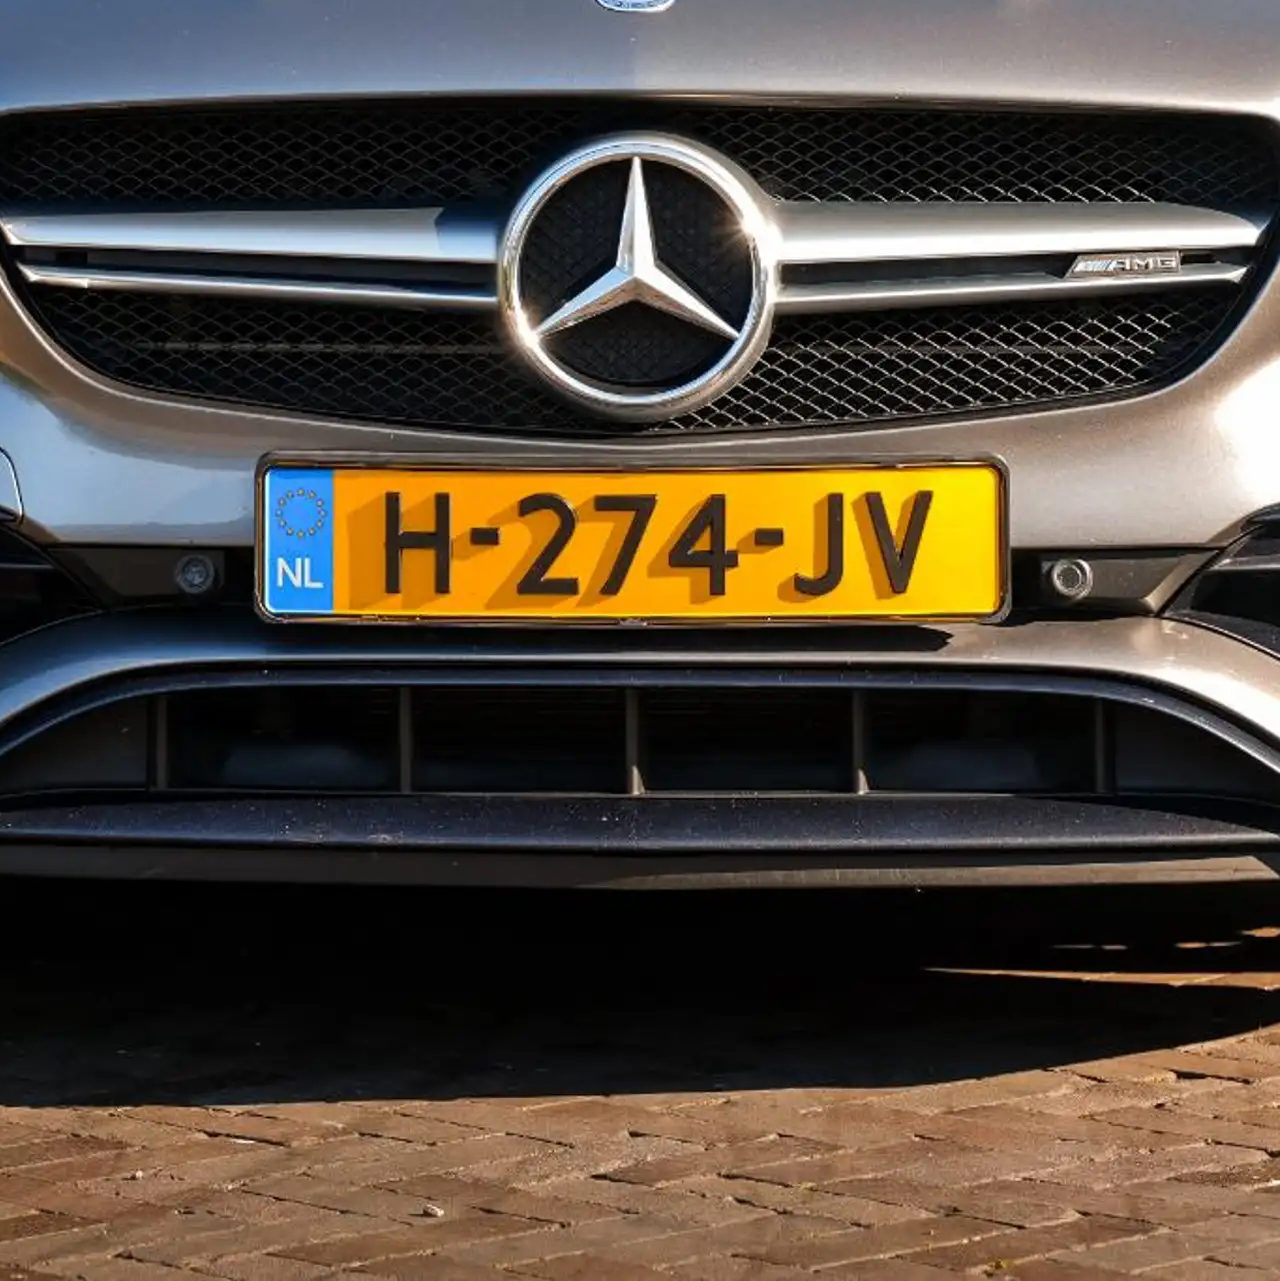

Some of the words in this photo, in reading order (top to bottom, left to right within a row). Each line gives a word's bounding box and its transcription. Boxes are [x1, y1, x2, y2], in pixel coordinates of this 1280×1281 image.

[1111, 255, 1176, 271] AMG
[383, 490, 934, 596] H-274-JV
[275, 558, 324, 588] NL
